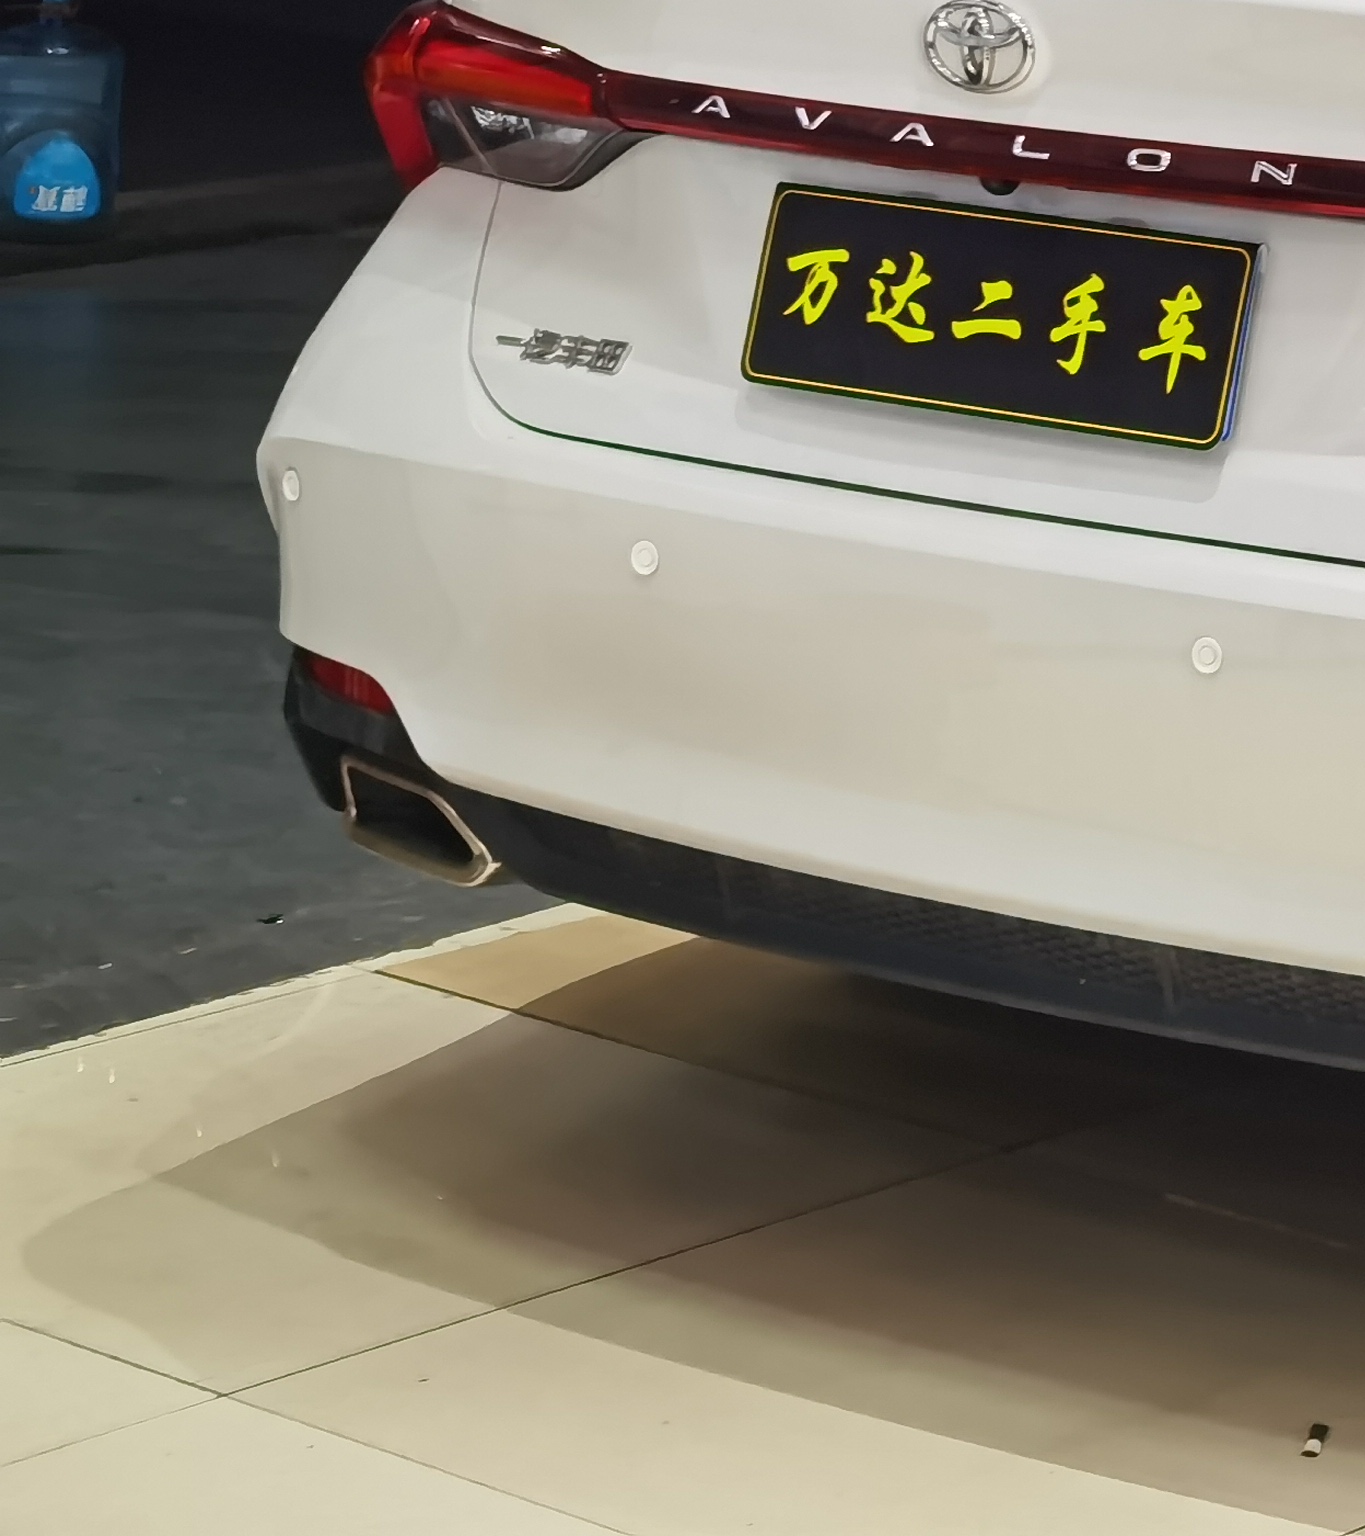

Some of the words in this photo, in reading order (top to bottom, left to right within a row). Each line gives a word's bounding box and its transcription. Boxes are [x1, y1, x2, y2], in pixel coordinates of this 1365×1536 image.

[692, 94, 1299, 185] AVALON
[782, 248, 1208, 394] 万达二手车
